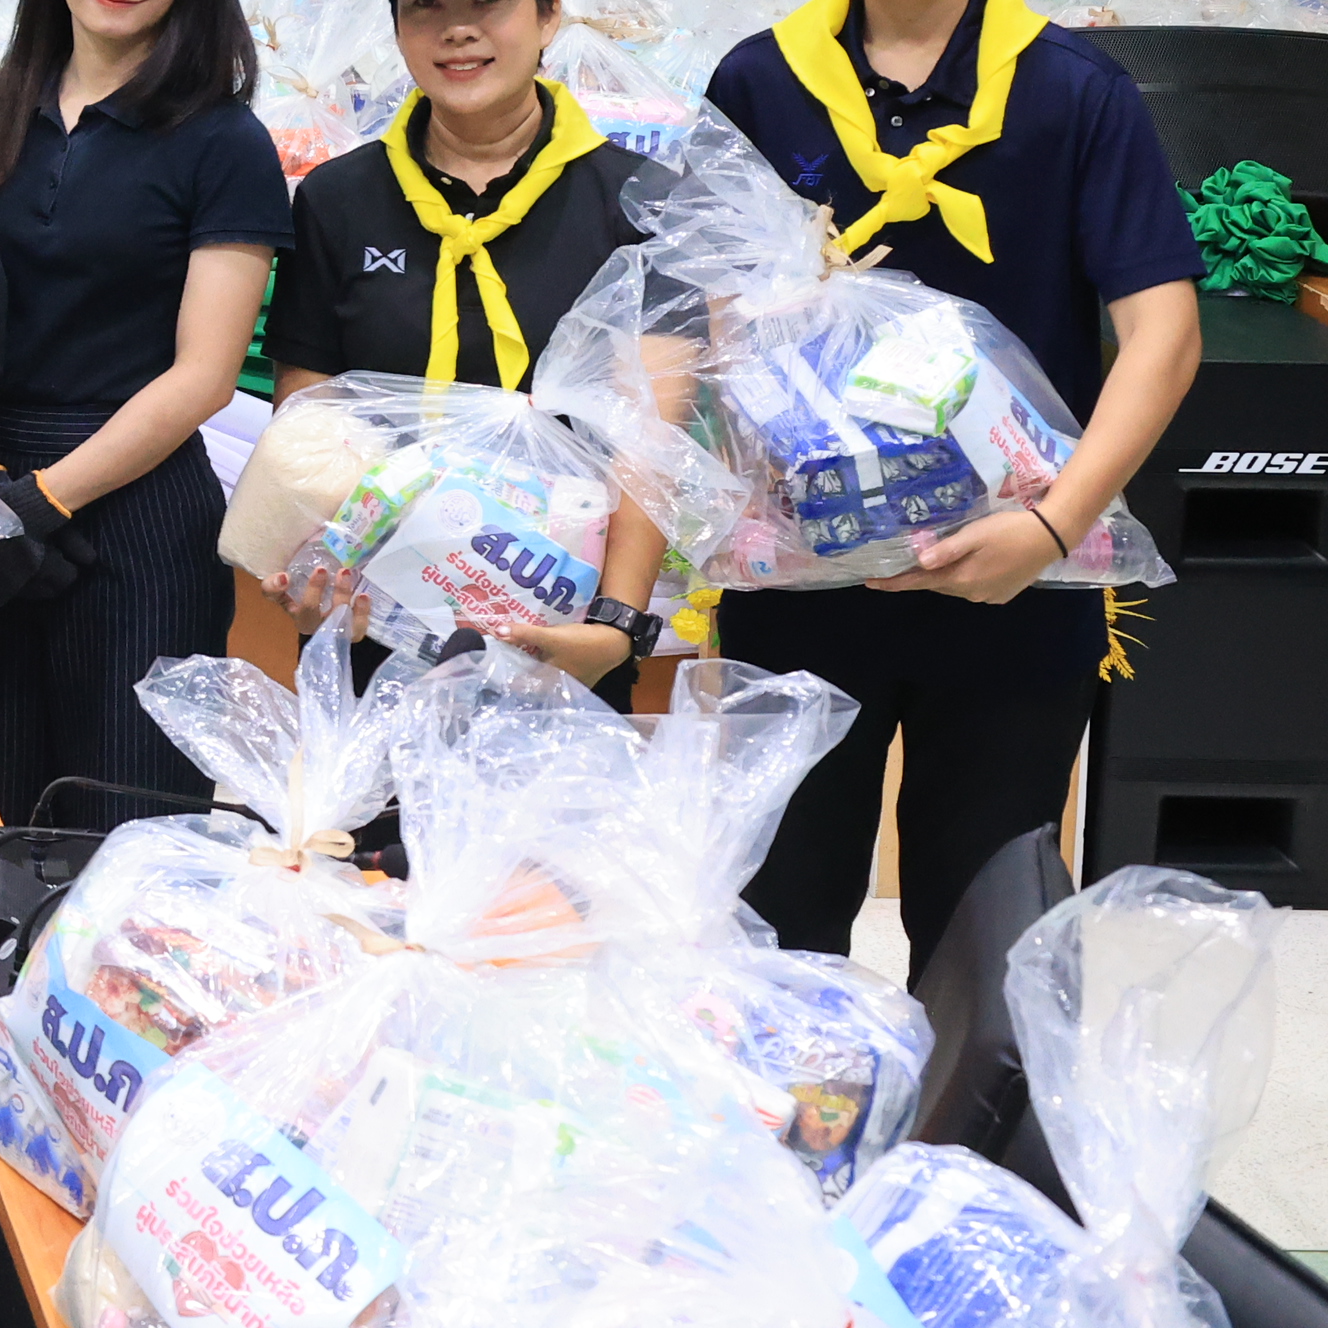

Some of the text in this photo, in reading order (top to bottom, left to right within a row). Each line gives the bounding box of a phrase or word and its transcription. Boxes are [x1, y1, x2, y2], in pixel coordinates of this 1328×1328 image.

[1178, 452, 1328, 474] BOSE
[166, 1177, 305, 1316] ร่วมใจช่วยเหลือ
[201, 1139, 354, 1301] ส.ป.ก.
